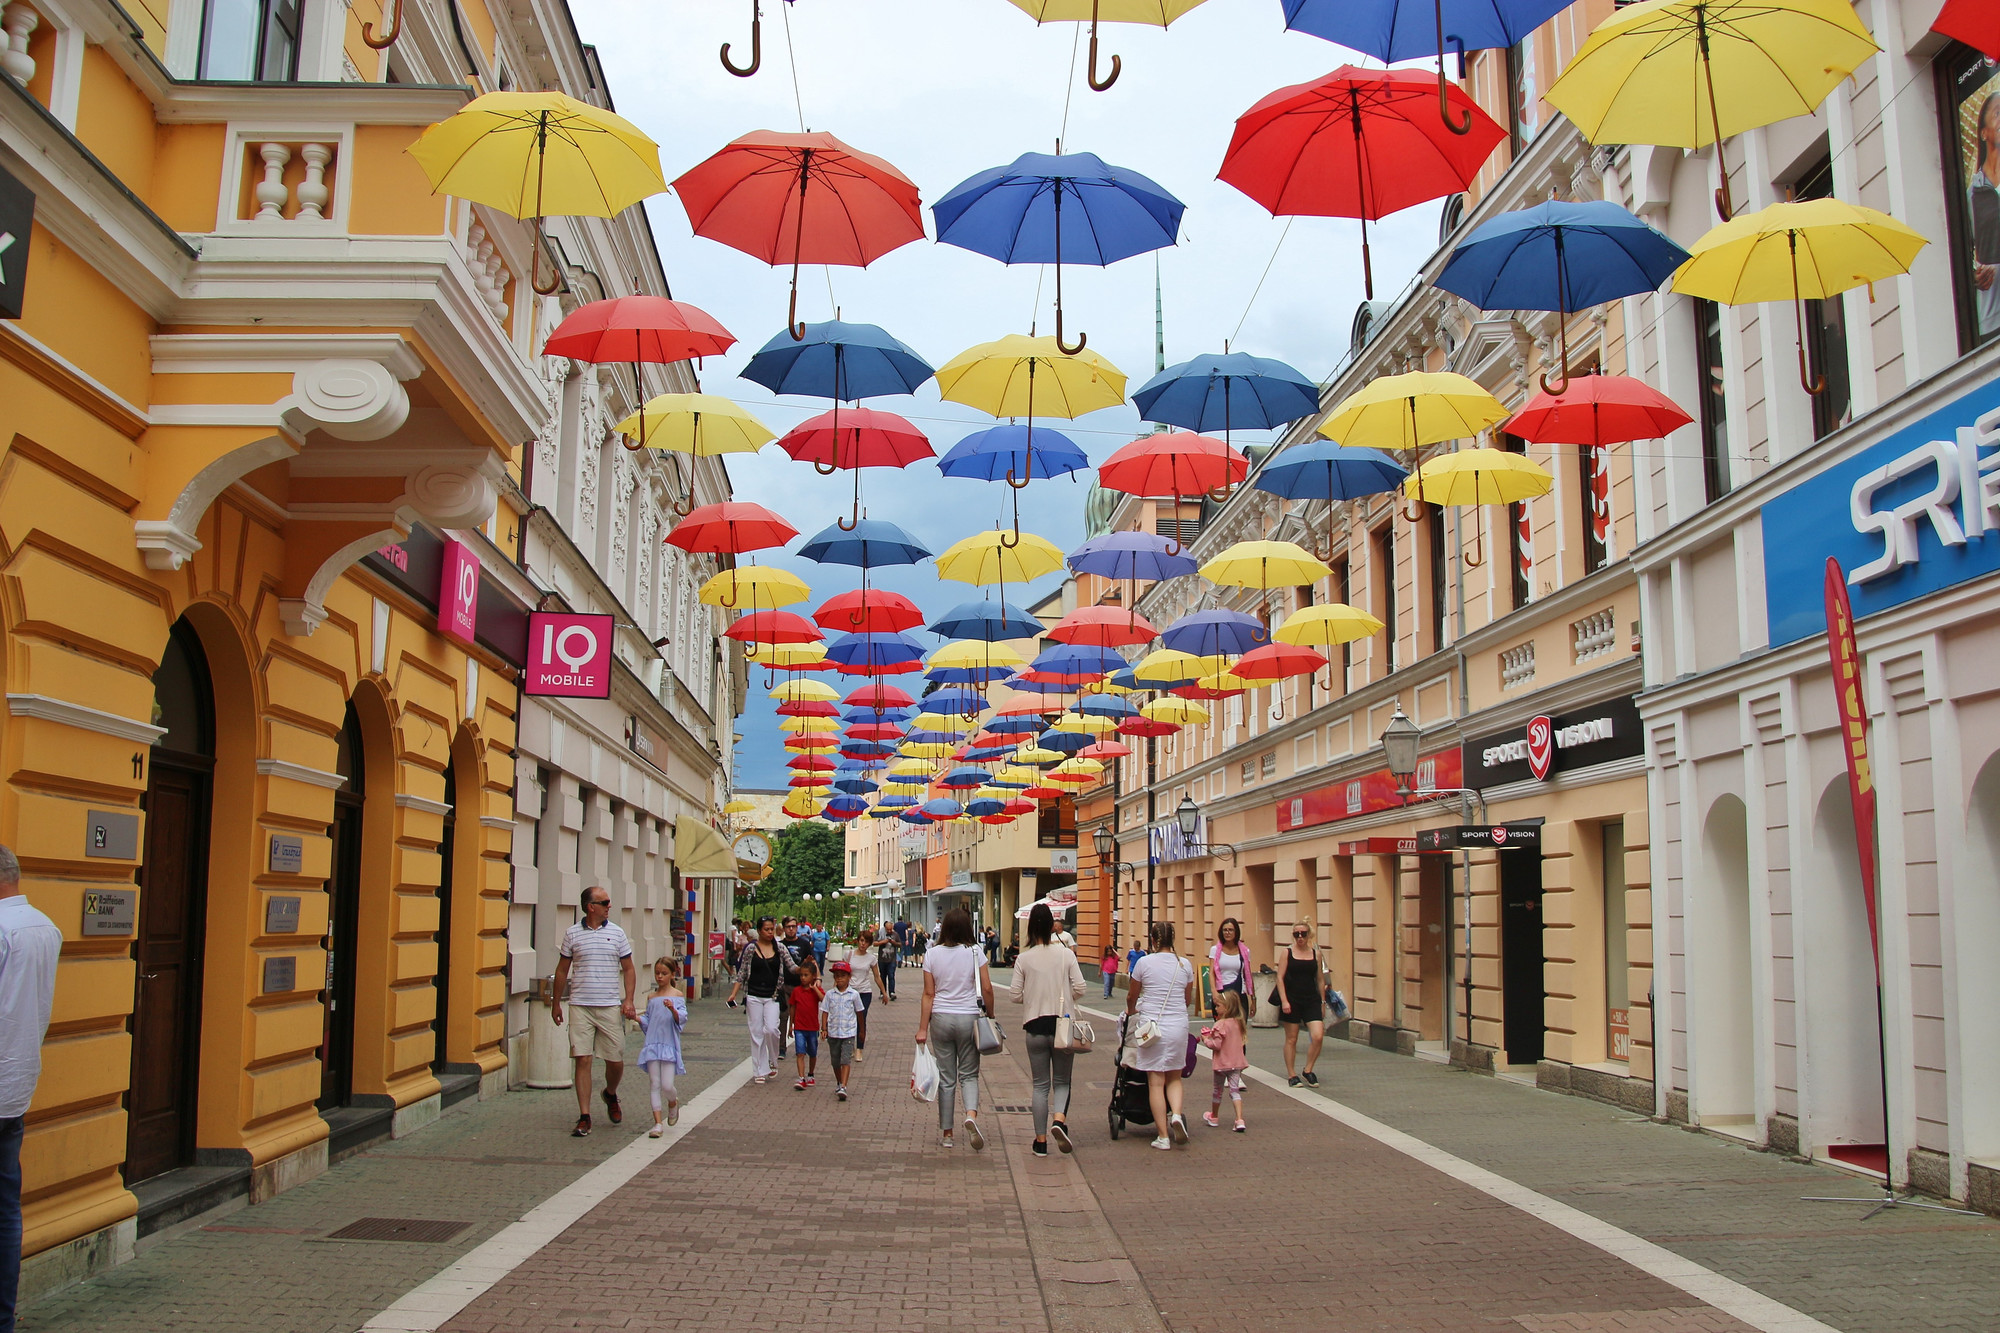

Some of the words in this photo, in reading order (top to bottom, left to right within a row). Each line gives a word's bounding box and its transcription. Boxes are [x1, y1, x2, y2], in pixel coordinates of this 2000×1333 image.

[1957, 58, 1983, 85] SPORT
[458, 558, 475, 614] IQ
[456, 611, 472, 629] MOBILE
[542, 624, 598, 674] IQ
[540, 674, 595, 687] MOBILE
[1482, 739, 1529, 768] SPORT
[1554, 717, 1613, 749] VISION
[131, 751, 144, 781] 11
[1397, 839, 1416, 850] cm
[1462, 831, 1490, 839] SPORT
[1507, 830, 1535, 838] VISION
[98, 906, 114, 915] BANK
